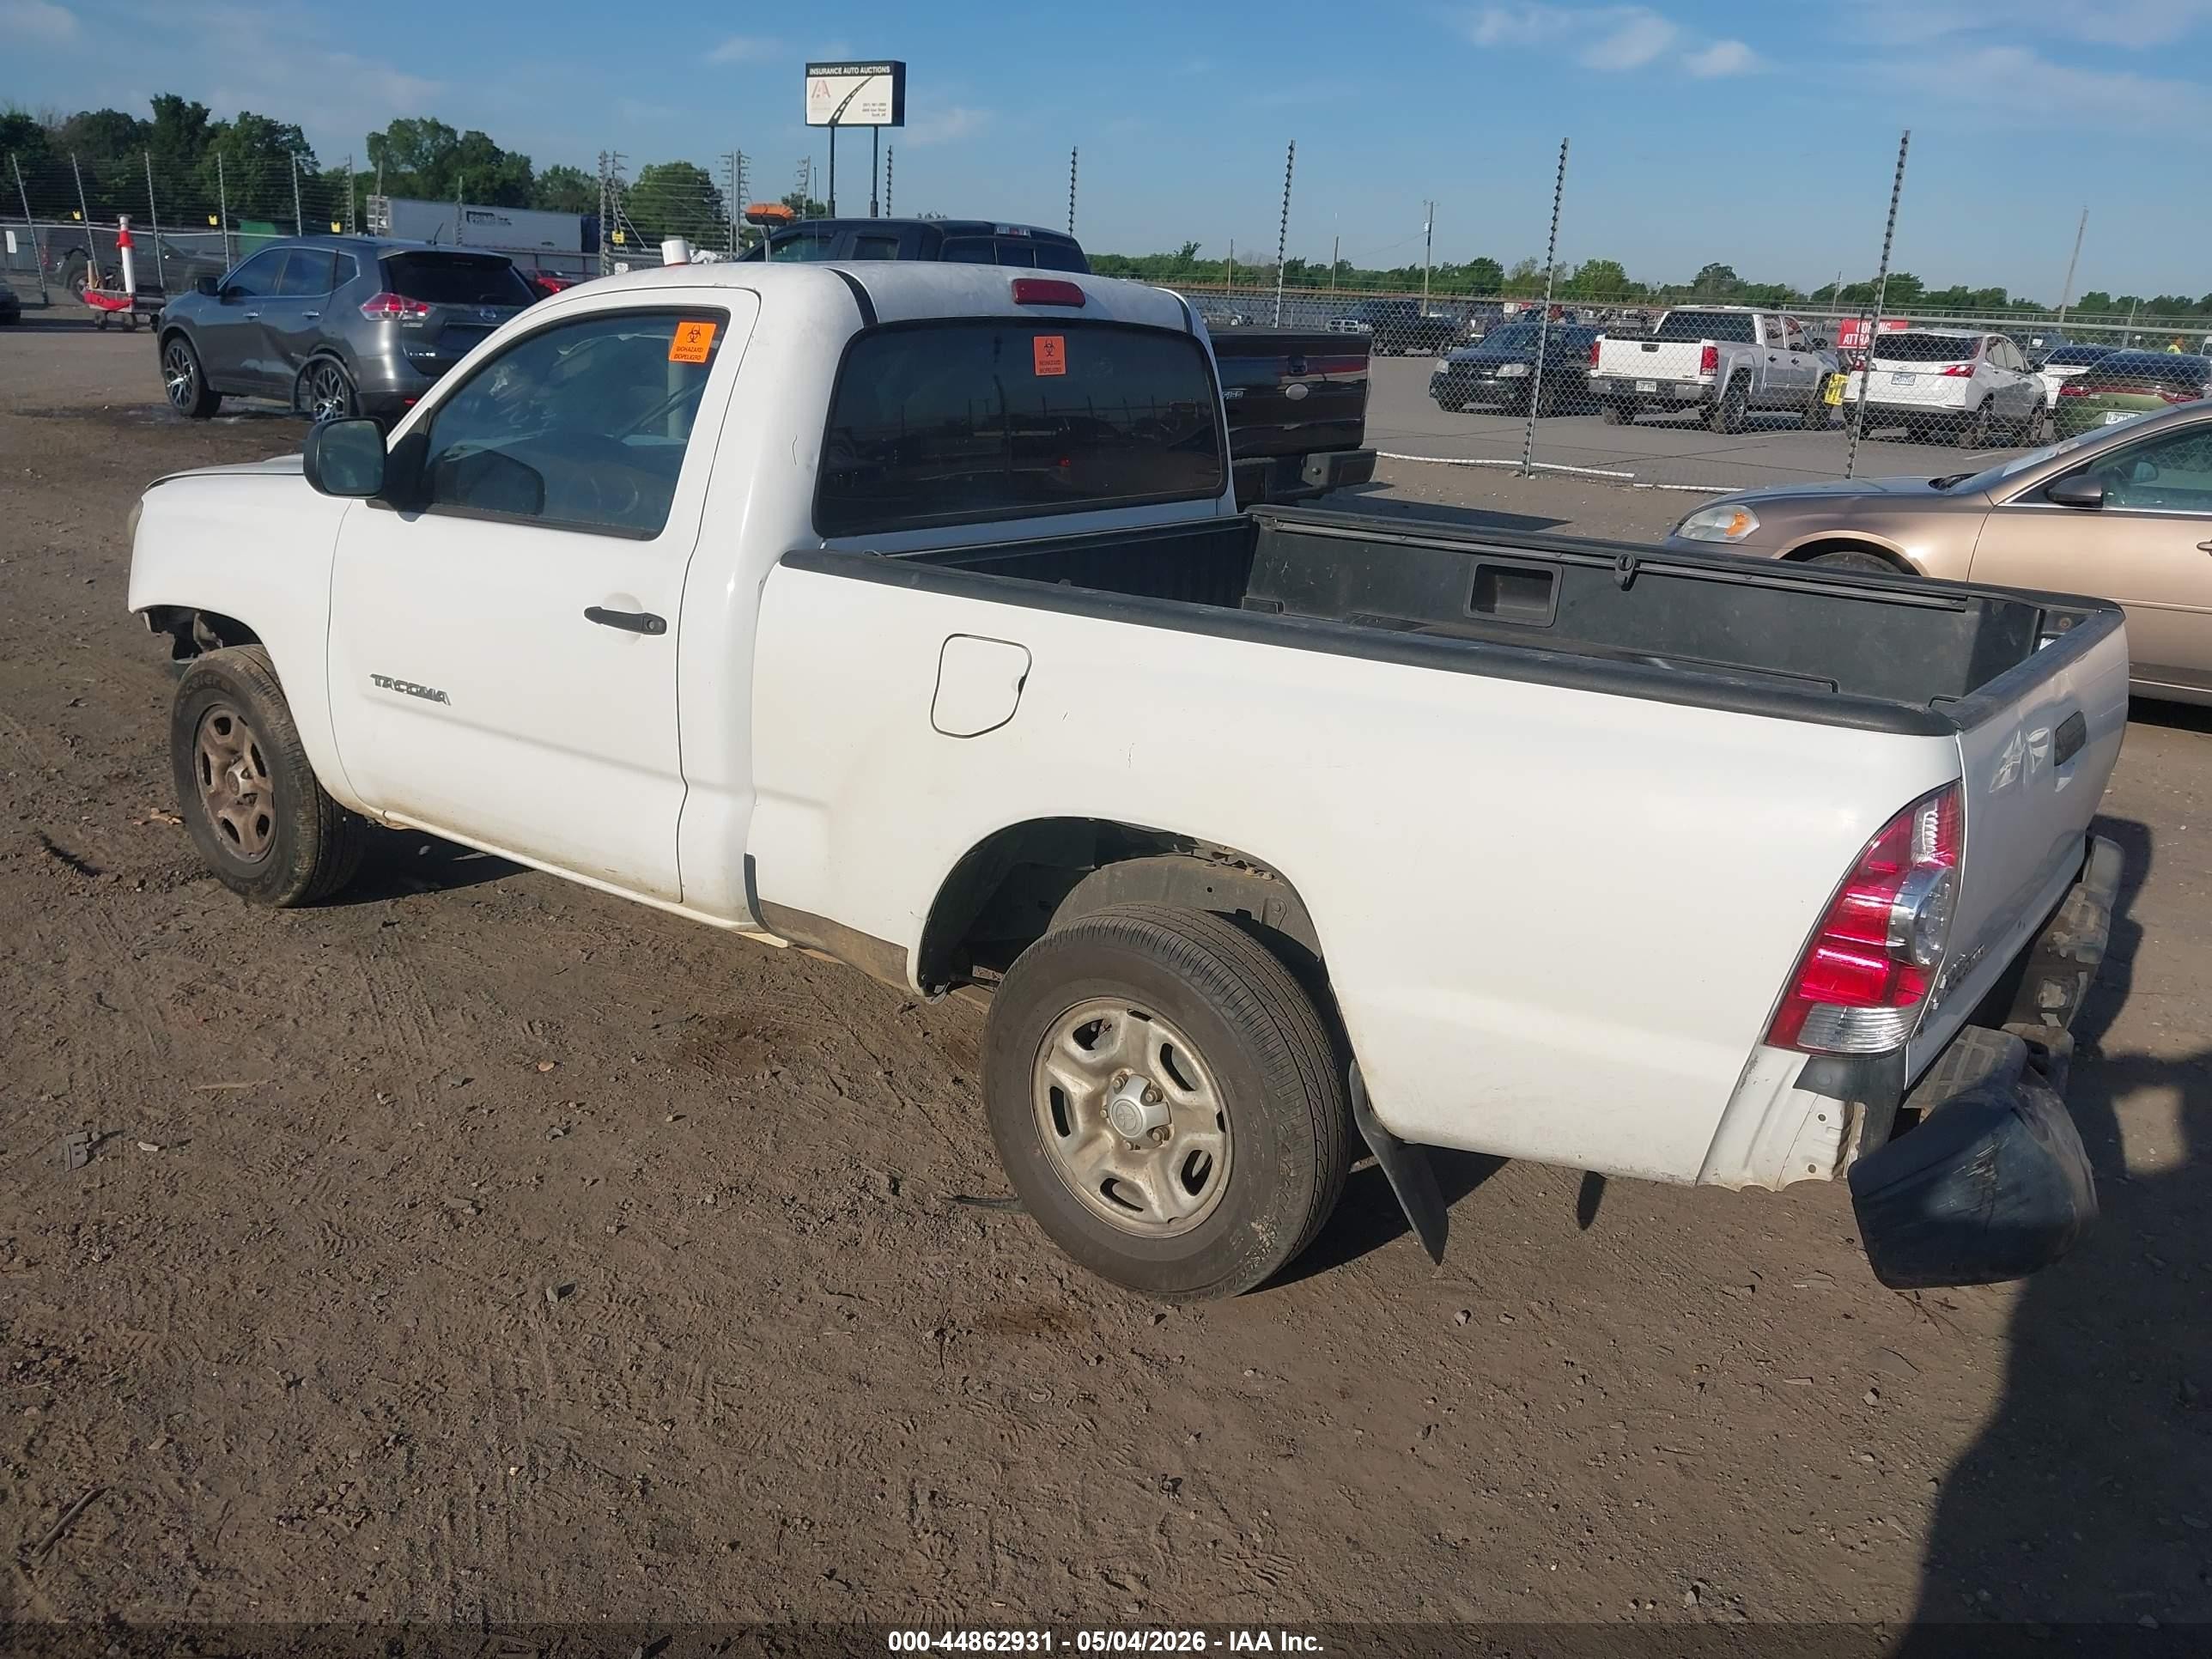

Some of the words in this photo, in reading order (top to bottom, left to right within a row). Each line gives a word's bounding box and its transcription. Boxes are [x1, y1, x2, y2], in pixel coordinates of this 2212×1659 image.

[809, 67, 842, 76] INSURANCE
[860, 65, 890, 74] AUCTIONS
[369, 673, 452, 706] TACOMA
